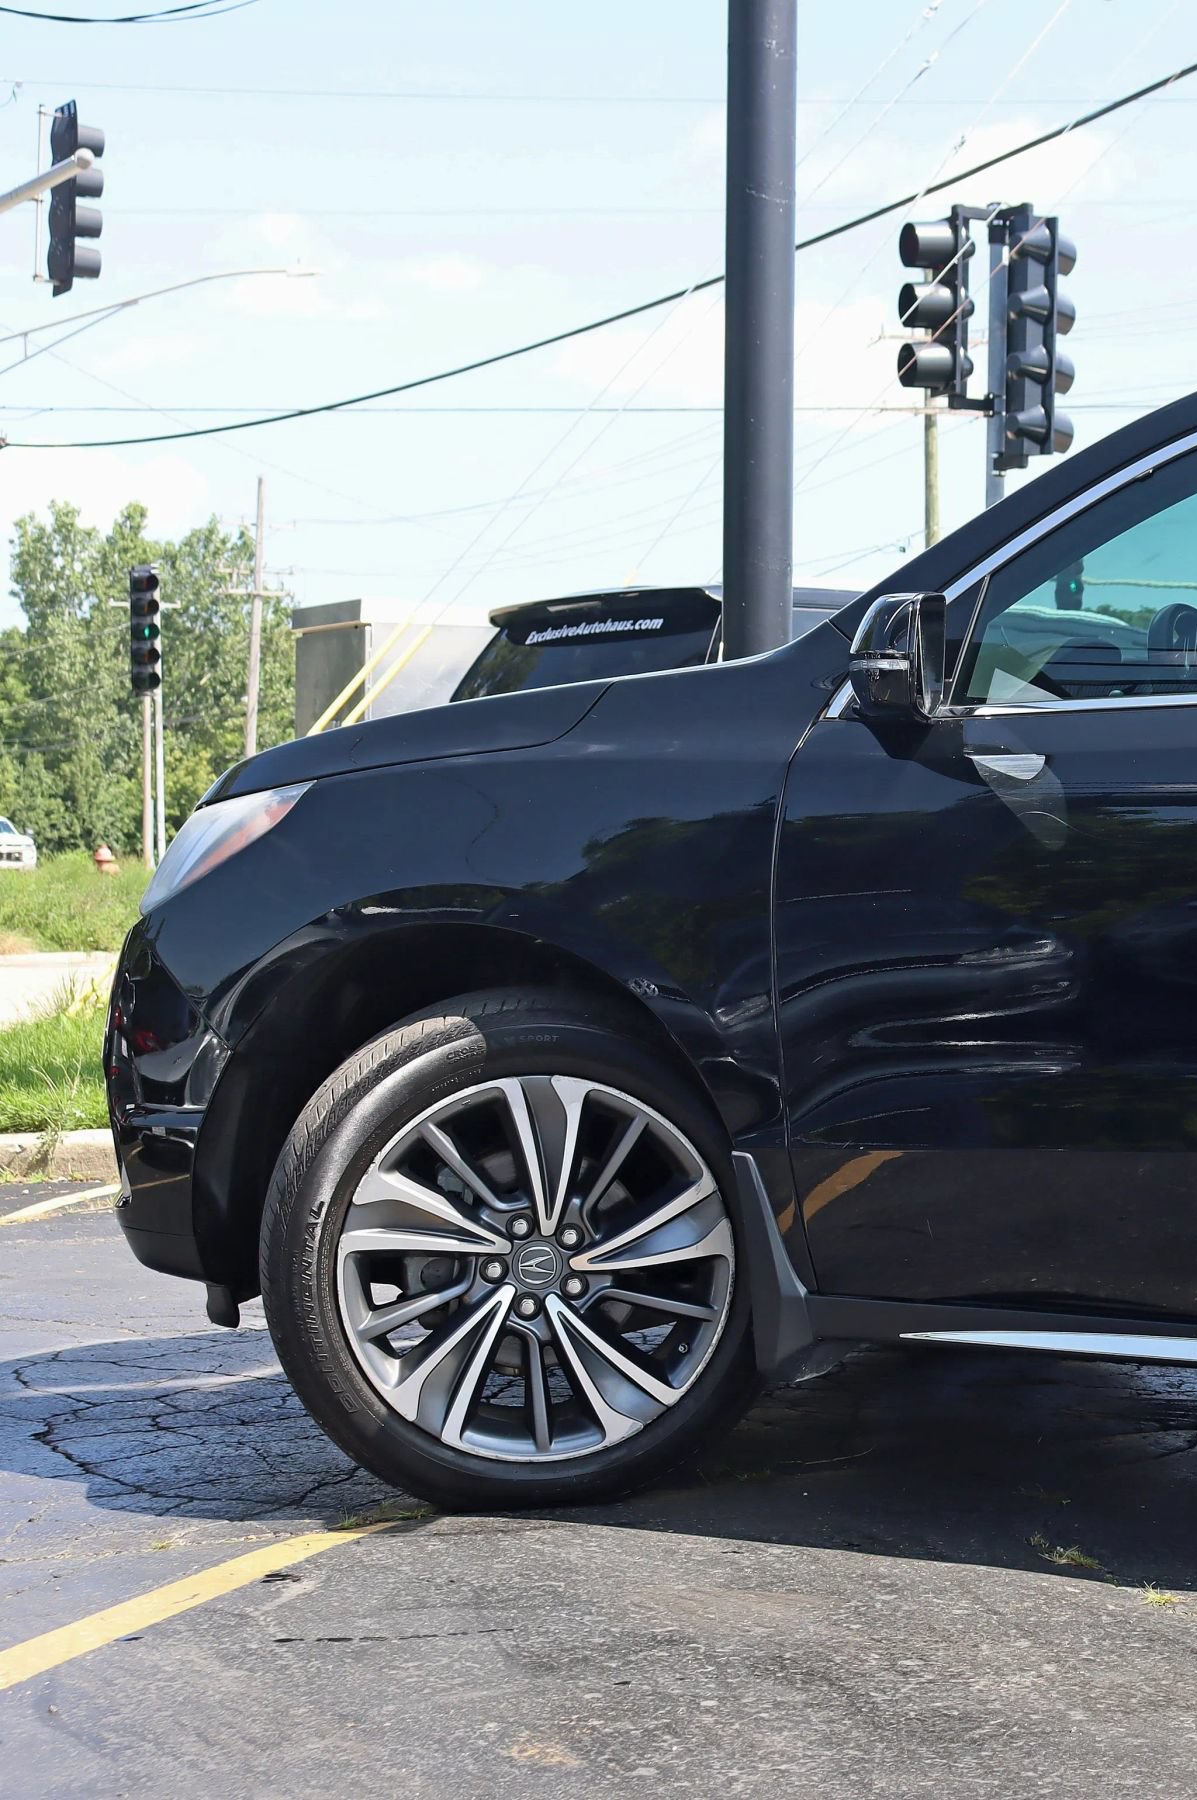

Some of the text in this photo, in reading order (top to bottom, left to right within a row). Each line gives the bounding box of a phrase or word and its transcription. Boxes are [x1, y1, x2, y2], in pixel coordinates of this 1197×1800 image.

[525, 617, 664, 645] ExclusiveAutohaus.com
[519, 1034, 560, 1043] SPORT
[446, 1043, 485, 1060] CROSS
